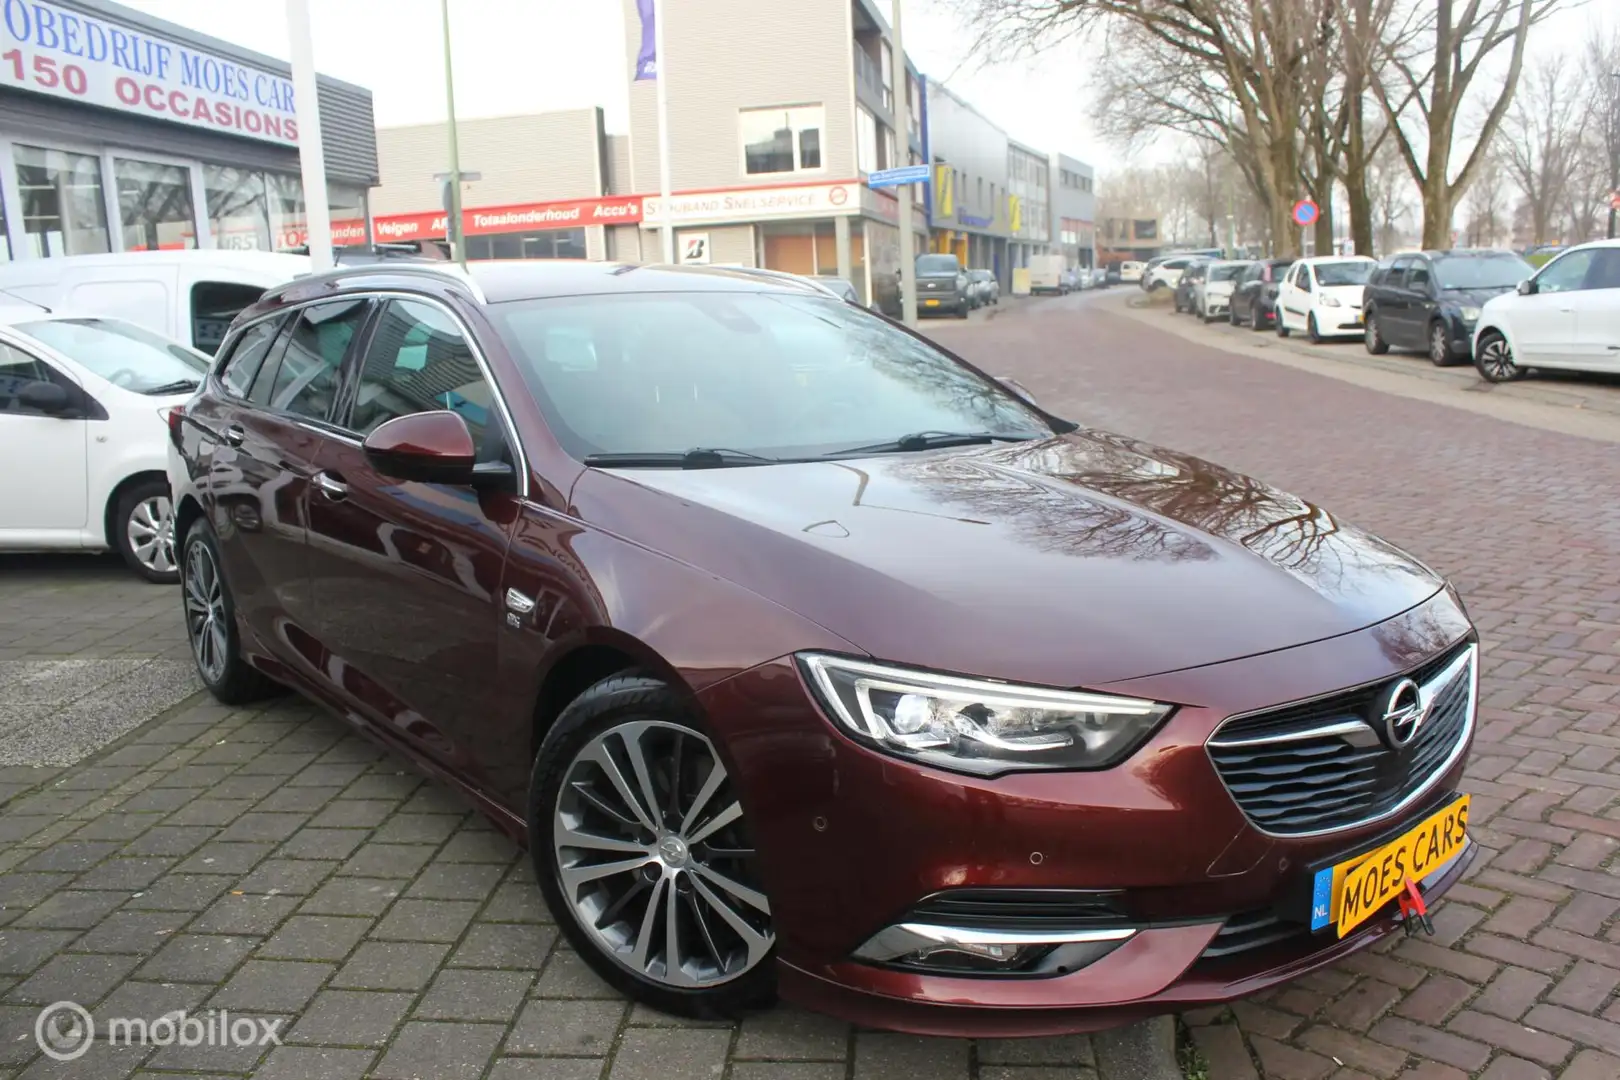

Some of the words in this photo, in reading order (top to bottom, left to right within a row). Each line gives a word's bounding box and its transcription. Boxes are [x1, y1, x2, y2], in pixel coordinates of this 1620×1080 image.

[3, 49, 88, 96] 150
[114, 76, 299, 142] OCCASIONS
[180, 50, 249, 102] MOES
[254, 73, 297, 114] CAR
[473, 208, 580, 228] Totaalonderhoud
[593, 202, 638, 218] Accu's
[1341, 845, 1407, 927] MOES
[1412, 804, 1468, 873] CARS
[1313, 903, 1328, 919] NL
